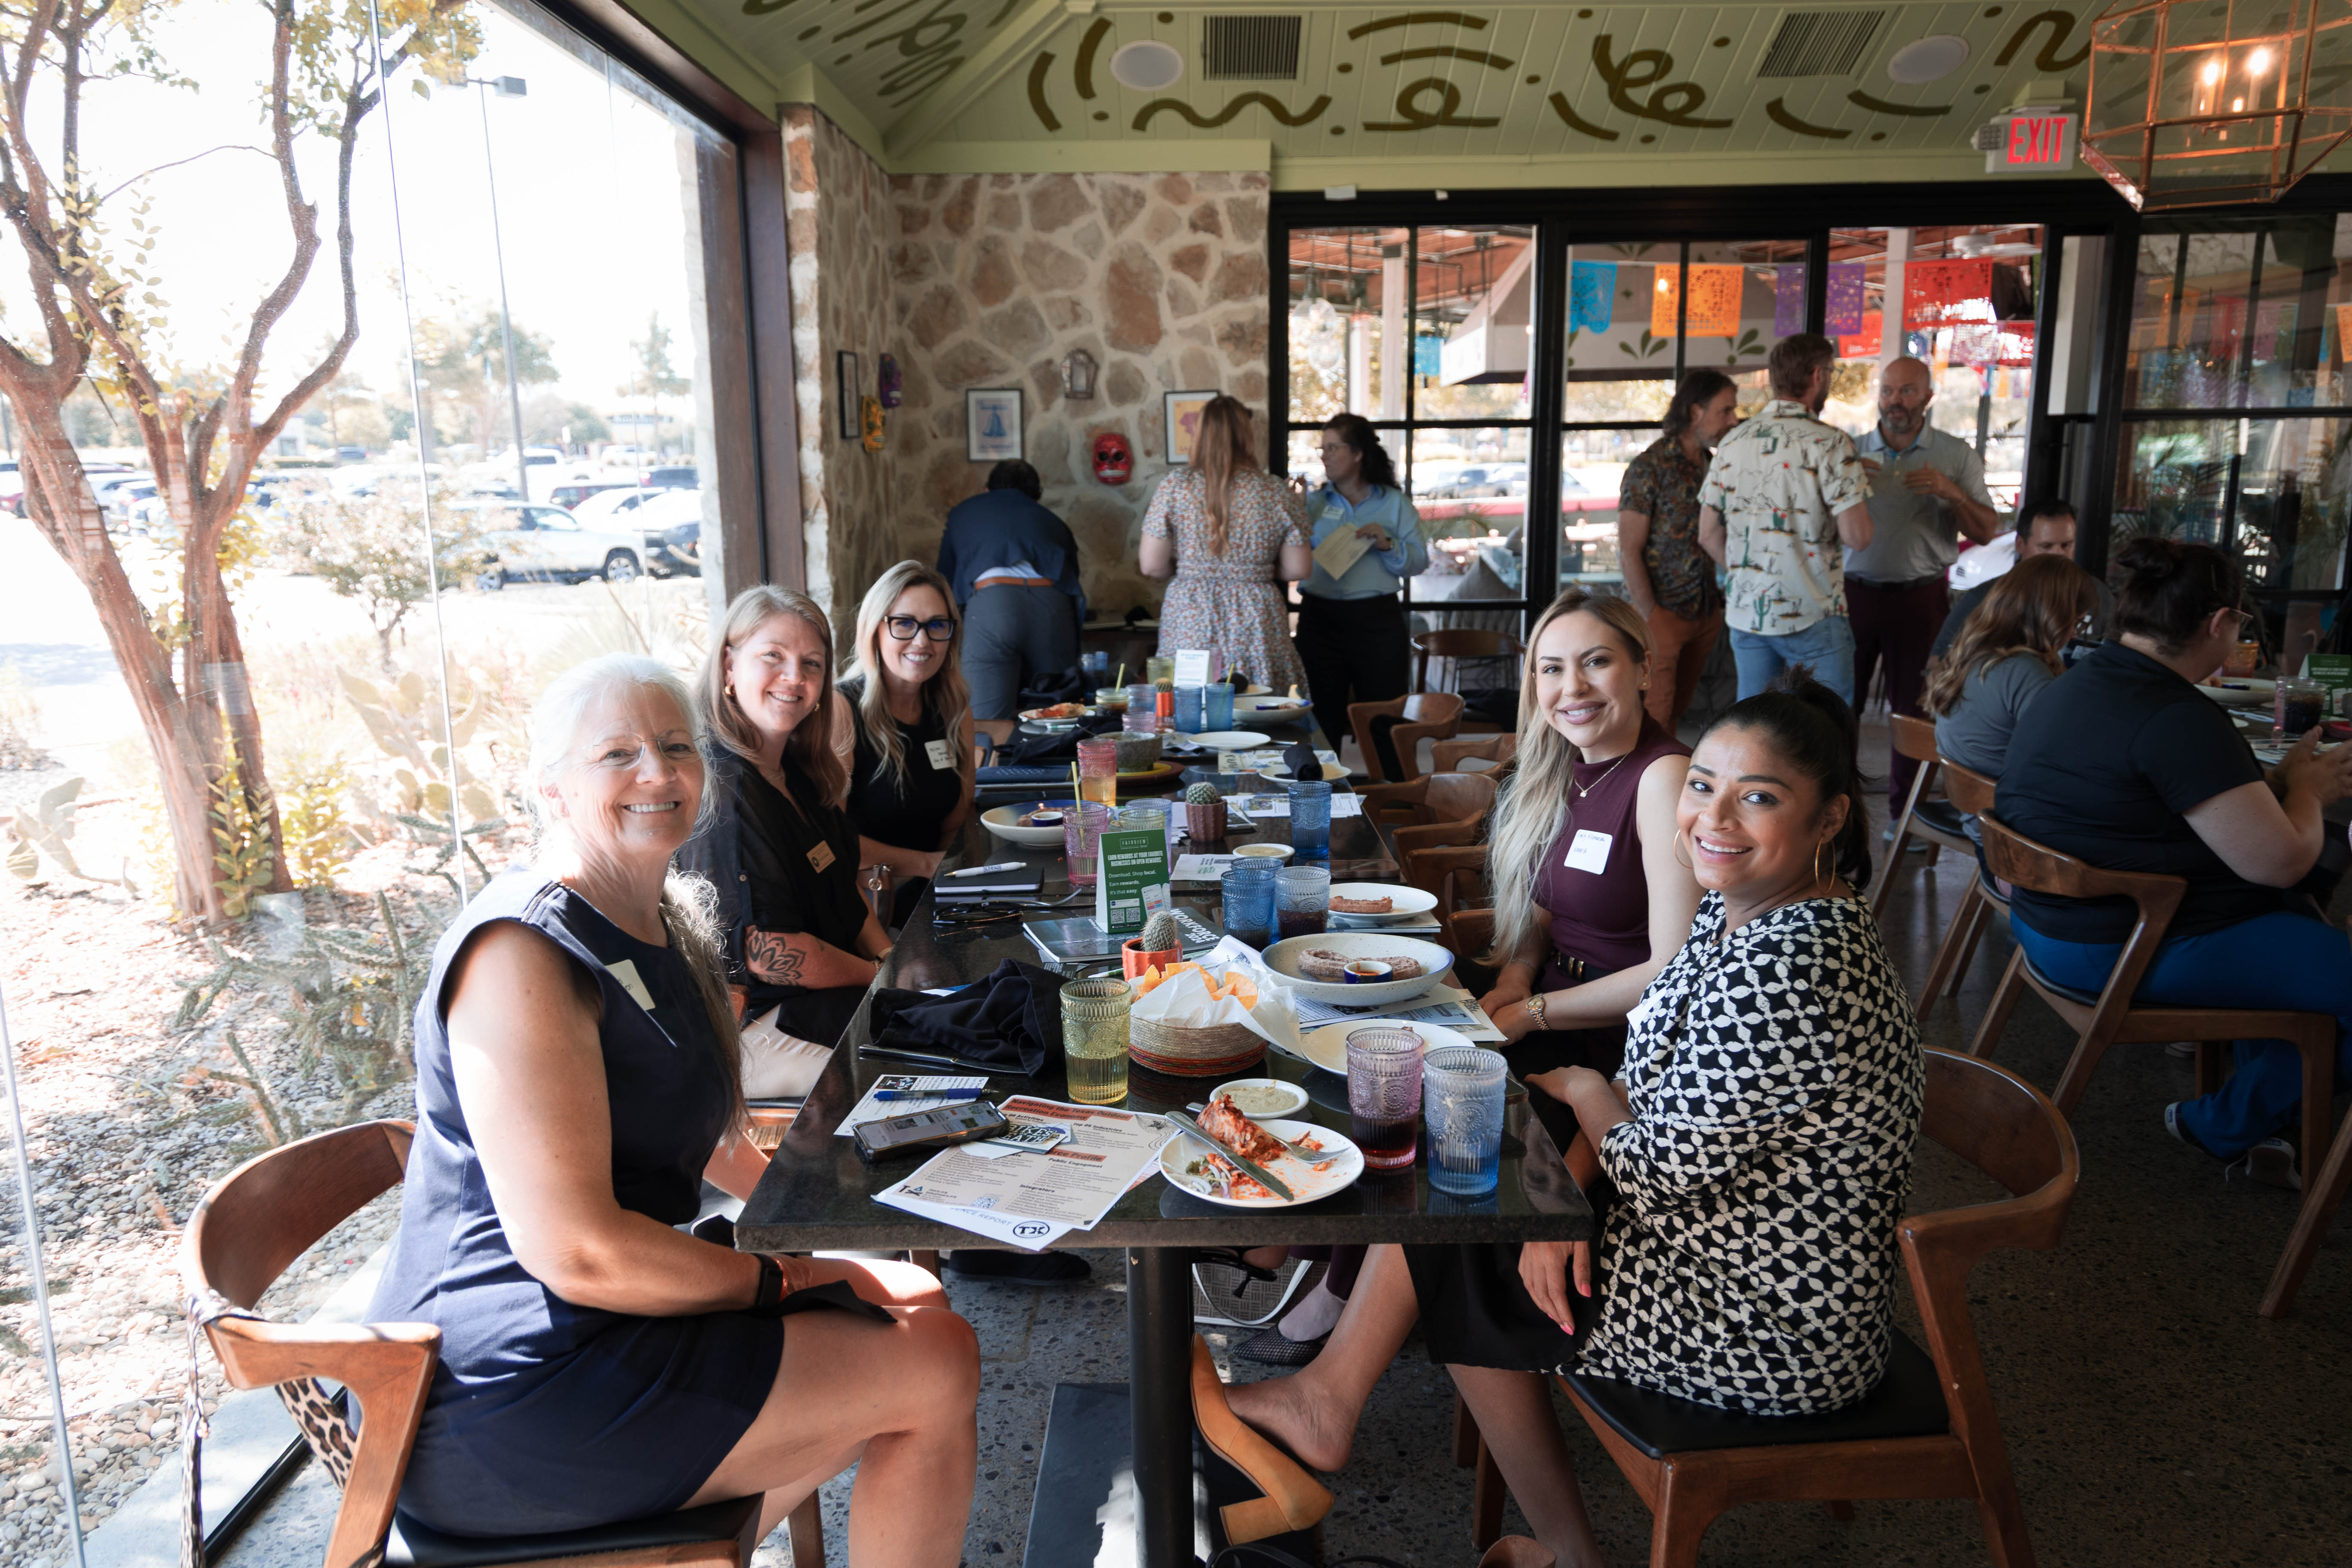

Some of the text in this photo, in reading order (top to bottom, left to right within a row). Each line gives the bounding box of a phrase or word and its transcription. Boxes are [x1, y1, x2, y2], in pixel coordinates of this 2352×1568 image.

[2007, 117, 2068, 164] EXIT
[1170, 908, 1220, 941] WORKFORCE
[1185, 933, 1206, 943] 2024
[1004, 1105, 1050, 1114] Recreation
[1012, 1099, 1054, 1110] Navigating
[1008, 1124, 1055, 1136] BIKES
[1003, 1132, 1047, 1142] EATH
[1070, 1153, 1102, 1161] Profile
[1019, 1184, 1056, 1192] Integrators
[979, 1214, 1013, 1225] REPORT
[1018, 1226, 1046, 1234] TX
